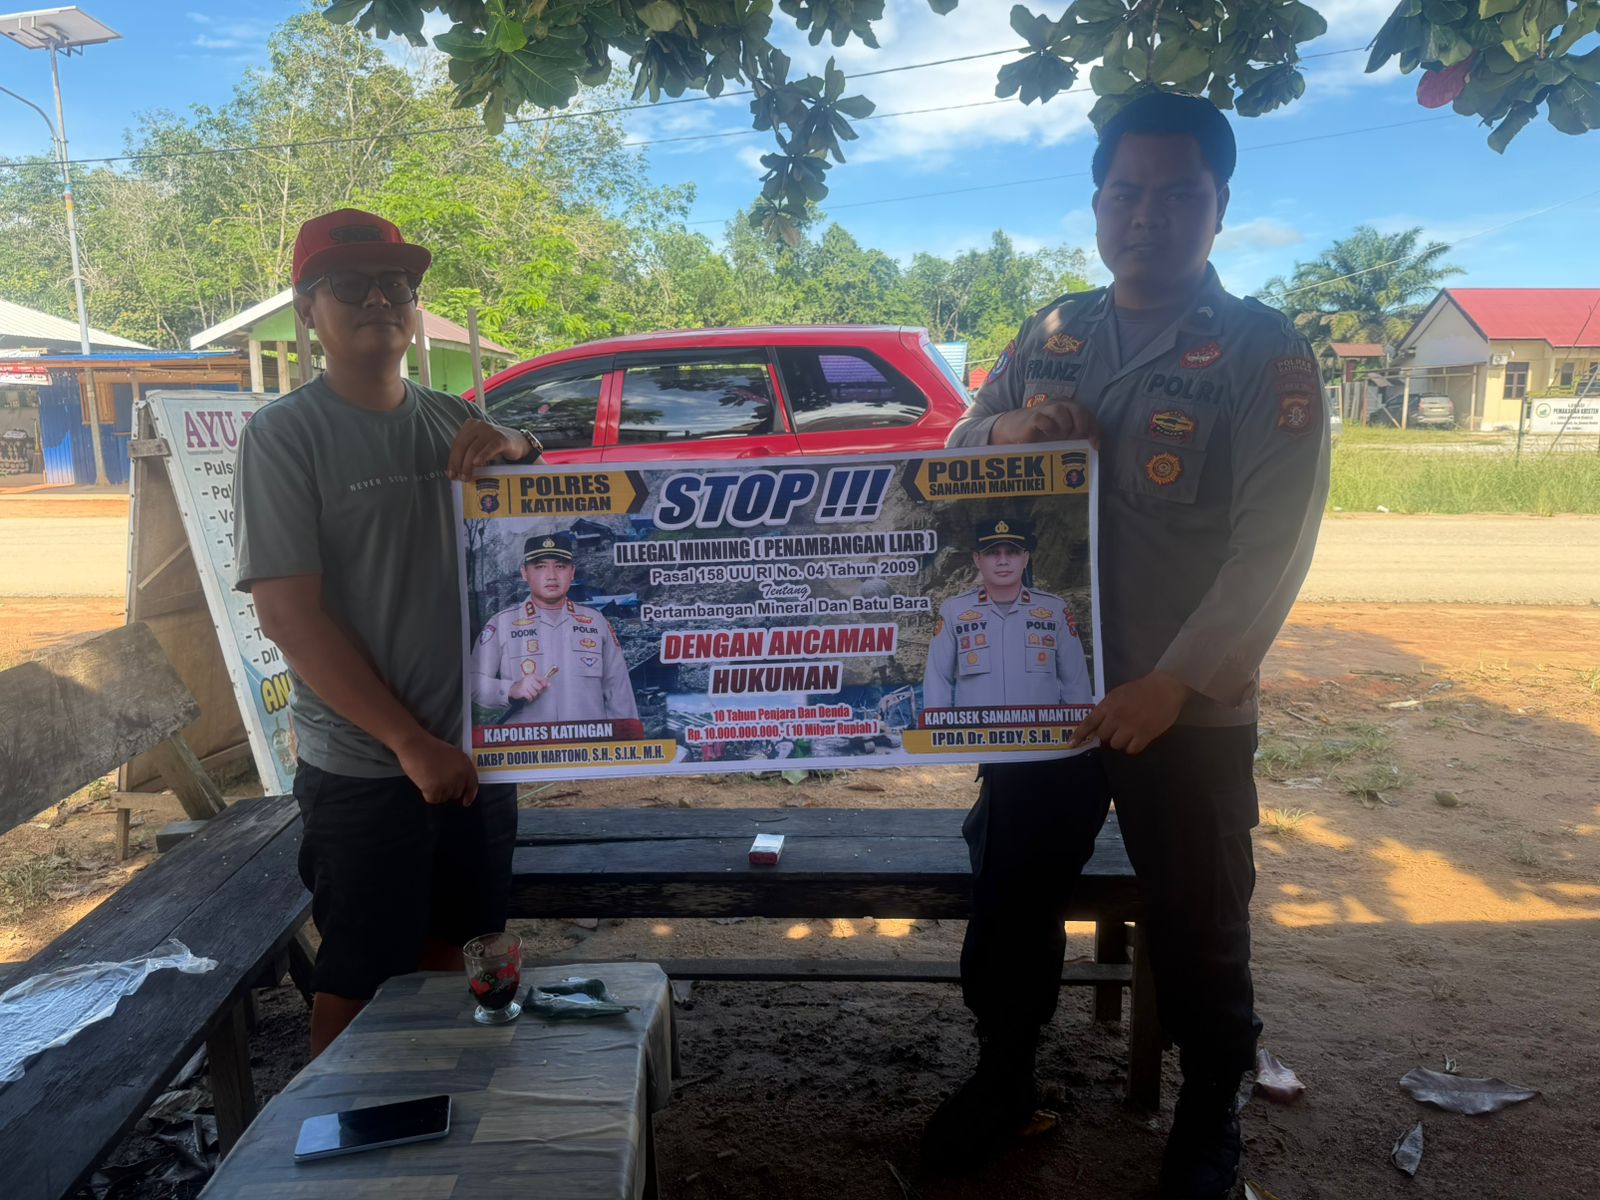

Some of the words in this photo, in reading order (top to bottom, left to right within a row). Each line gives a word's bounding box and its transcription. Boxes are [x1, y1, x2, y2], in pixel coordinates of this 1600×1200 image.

[1026, 359, 1081, 381] FRANZ
[1147, 373, 1224, 404] POLRI
[184, 411, 237, 448] AYU
[204, 460, 236, 476] Puls
[928, 456, 1046, 482] POLSEK
[350, 478, 381, 491] NEVER
[520, 474, 610, 497] POLRES
[929, 480, 986, 496] SANAMAN
[988, 477, 1046, 494] MANTIKEI
[521, 496, 611, 514] KATINGAN
[657, 472, 816, 527] STOP
[819, 467, 893, 520] !!!
[616, 542, 676, 564] ILLEGAL
[678, 540, 750, 562] MINNING
[764, 534, 886, 559] PENAMBANGAN
[889, 533, 924, 551] LIAR
[652, 569, 693, 584] Pasal
[698, 568, 724, 582] 158
[729, 568, 751, 581] UU
[756, 567, 773, 580] RI
[777, 565, 801, 579] No.
[807, 564, 825, 577] 04
[829, 562, 876, 576] Tahun
[880, 560, 917, 574] 2009
[763, 583, 809, 598] Tentang
[643, 604, 753, 620] Pertambangan
[758, 601, 813, 615] Mineral
[818, 601, 848, 613] Dan
[853, 599, 888, 612] Batu
[893, 598, 929, 610] Bara
[511, 629, 538, 639] DODIK
[573, 625, 598, 635] POLRI
[956, 622, 988, 634] DEDY
[1026, 621, 1056, 631] POLRI
[664, 631, 764, 660] DENGAN
[768, 626, 894, 656] ANCAMAN
[711, 664, 840, 695] HUKUMAN
[714, 710, 724, 722] 10
[727, 709, 755, 722] Tahun
[758, 707, 796, 722] Penjara
[798, 706, 816, 720] Dan
[818, 705, 850, 719] Denda
[925, 711, 979, 725] KAPOLSEK
[982, 709, 1036, 724] SANAMAN
[484, 727, 548, 743] KAPOLRES
[551, 724, 613, 739] KATINGAN
[687, 729, 702, 743] Rp.
[792, 724, 802, 736] 10
[804, 724, 835, 737] Milyar
[837, 722, 871, 737] Rupiah
[932, 732, 964, 745] IPDA
[967, 731, 986, 744] Dr.
[989, 730, 1024, 744] DEDY,
[476, 753, 504, 768] AKBP
[507, 751, 540, 767] DODIK
[541, 750, 591, 764] HARTONO,
